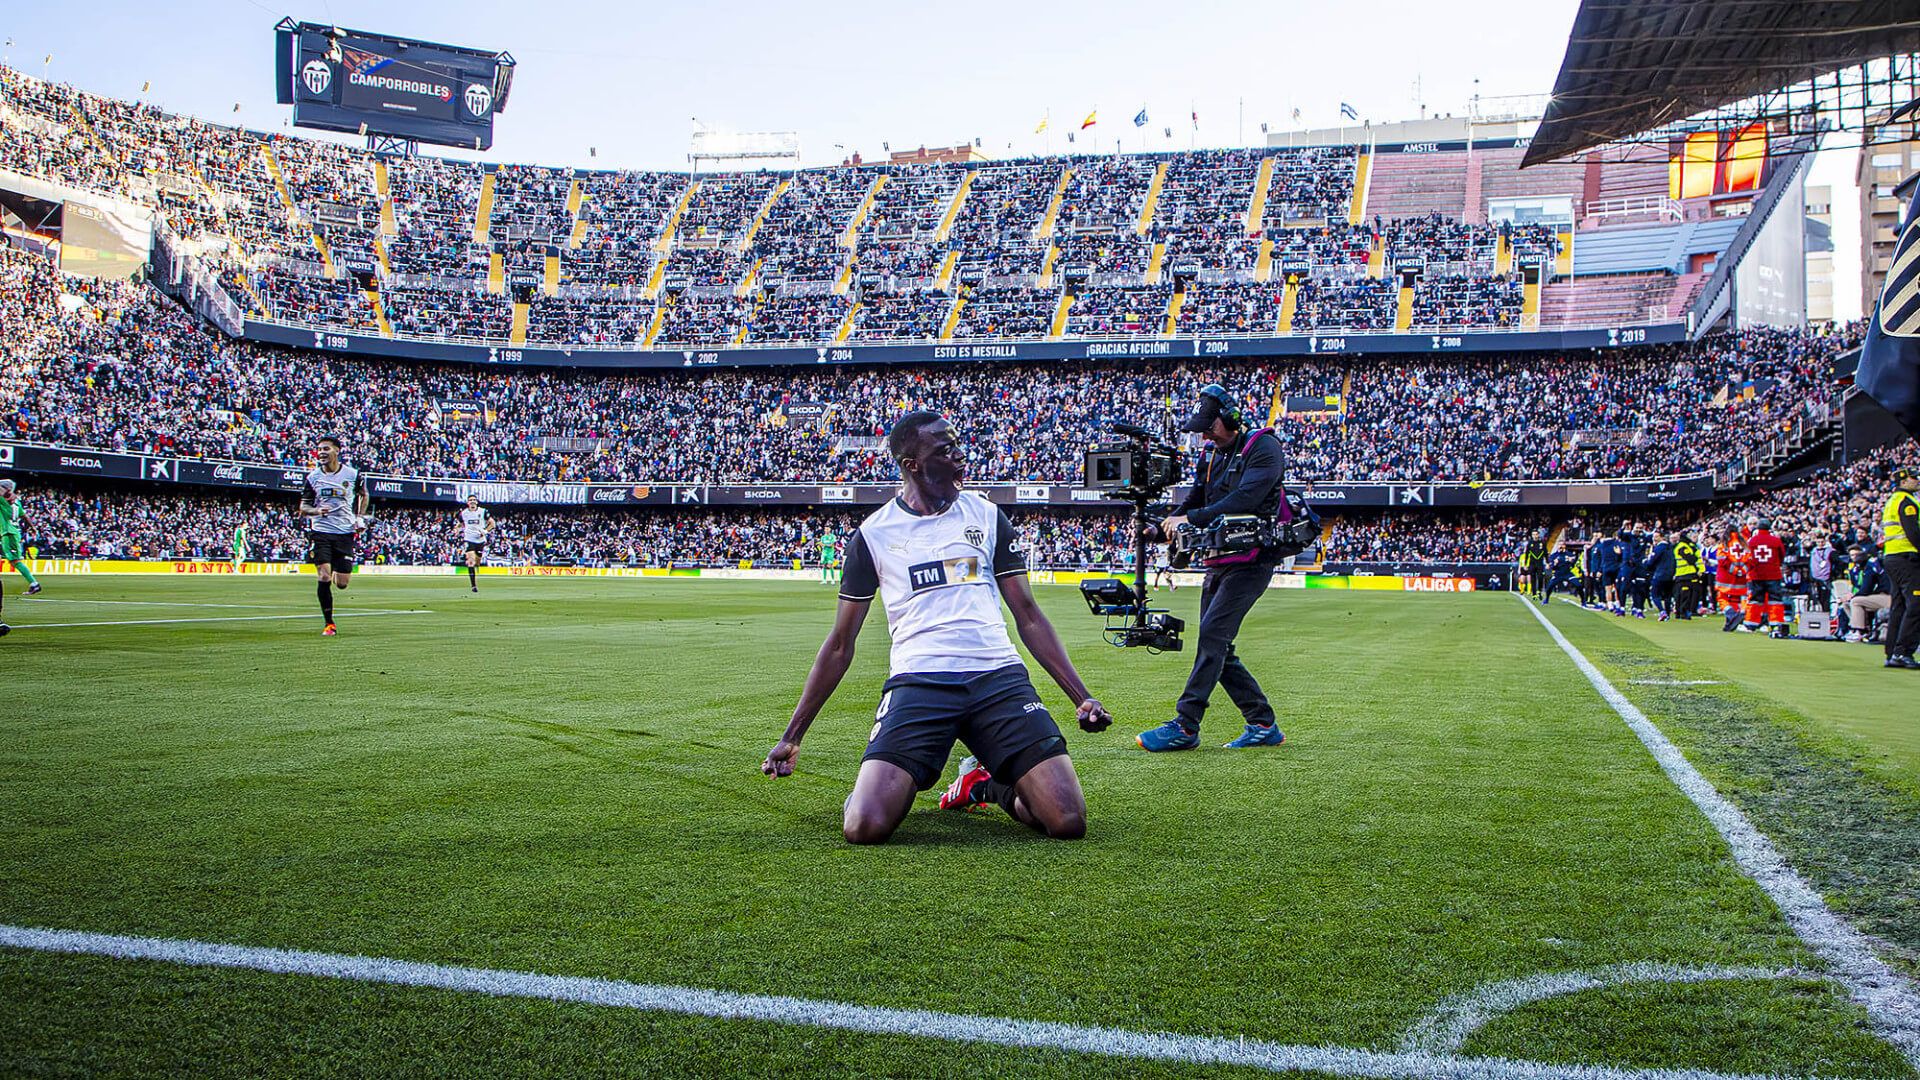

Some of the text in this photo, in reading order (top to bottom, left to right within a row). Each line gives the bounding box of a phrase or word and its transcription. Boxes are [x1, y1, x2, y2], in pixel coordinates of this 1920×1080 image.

[349, 72, 450, 98] CAMPORROBLES
[1402, 143, 1438, 153] AMSTEL
[346, 260, 373, 271] AMSTEL
[1396, 258, 1424, 268] AMSTEL
[1519, 254, 1546, 264] AMSTEL
[1285, 262, 1309, 271] AMSTEL
[512, 275, 538, 285] AMSTEL
[326, 335, 349, 349] 1999
[1621, 331, 1645, 344] 2019
[1086, 340, 1170, 357] ¡GRACIAS AFICIÓN!
[1205, 341, 1229, 354] 2004
[1321, 338, 1346, 351] 2004
[500, 350, 523, 362] 1999
[698, 352, 719, 364] 2002
[831, 350, 853, 361] 2004
[934, 345, 1017, 358] ESTO ES MESTALLA
[374, 481, 403, 493] AMSTEL
[456, 484, 469, 502] LA
[471, 485, 509, 503] CURVA
[528, 484, 586, 504] MESTALLA
[31, 559, 92, 574] LALIGA
[913, 567, 940, 586] TM
[1404, 577, 1455, 592] LALIGA
